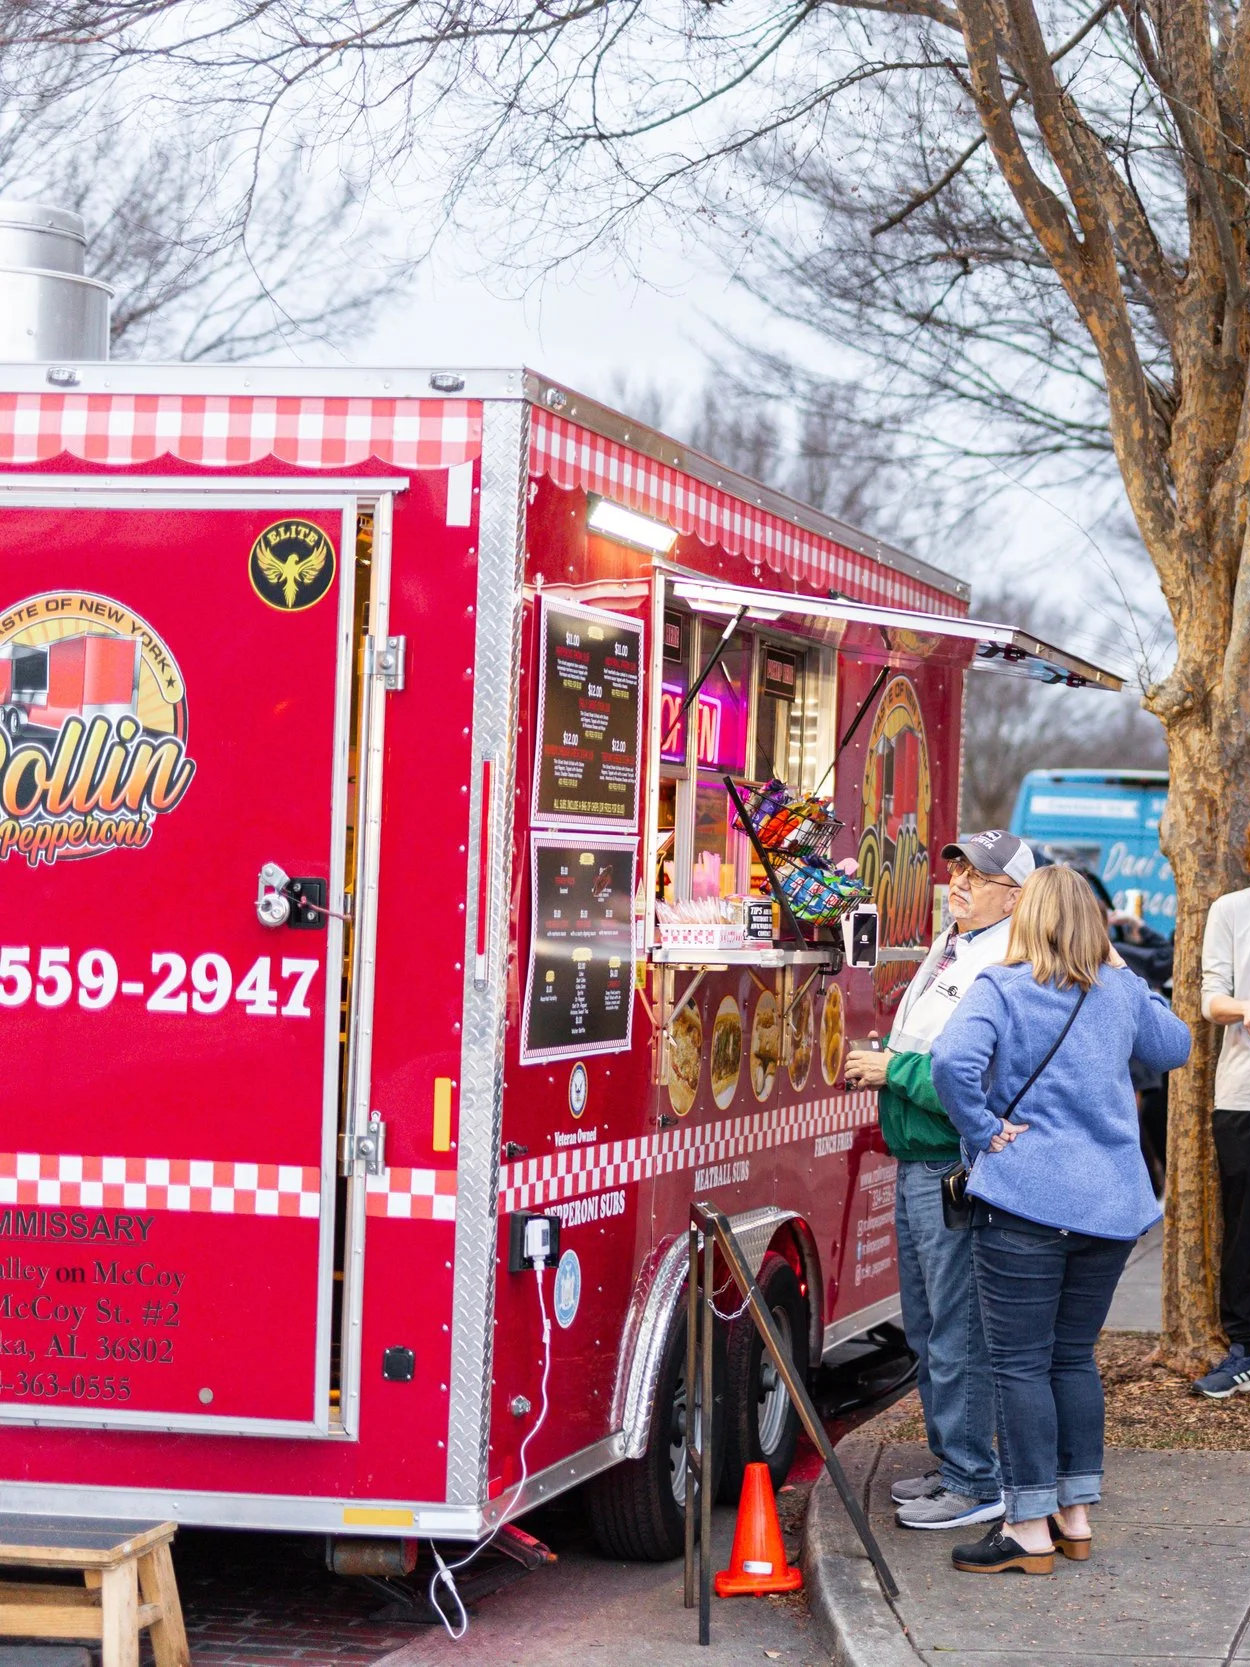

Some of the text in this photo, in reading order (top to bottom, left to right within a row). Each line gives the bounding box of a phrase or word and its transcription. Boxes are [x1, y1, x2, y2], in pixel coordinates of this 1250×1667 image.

[267, 526, 318, 546] ELITE
[45, 598, 72, 612] OF
[79, 599, 125, 623] NEW
[130, 620, 171, 674] YORK
[0, 718, 194, 817] ollin
[0, 812, 150, 866] Pepperoni
[0, 946, 319, 1016] 559-2947
[554, 1126, 597, 1147] Veteran Owned
[814, 1135, 836, 1158] FRENCH
[694, 1160, 749, 1192] MEATBALL SUBS
[600, 1190, 625, 1219] SUBS
[56, 1266, 85, 1284] on
[93, 1260, 186, 1295] McCoy
[96, 1298, 131, 1324] St.
[142, 1300, 180, 1327] #2
[45, 1333, 87, 1359] AL
[96, 1336, 174, 1364] 36802
[0, 1371, 131, 1401] -363-0555
